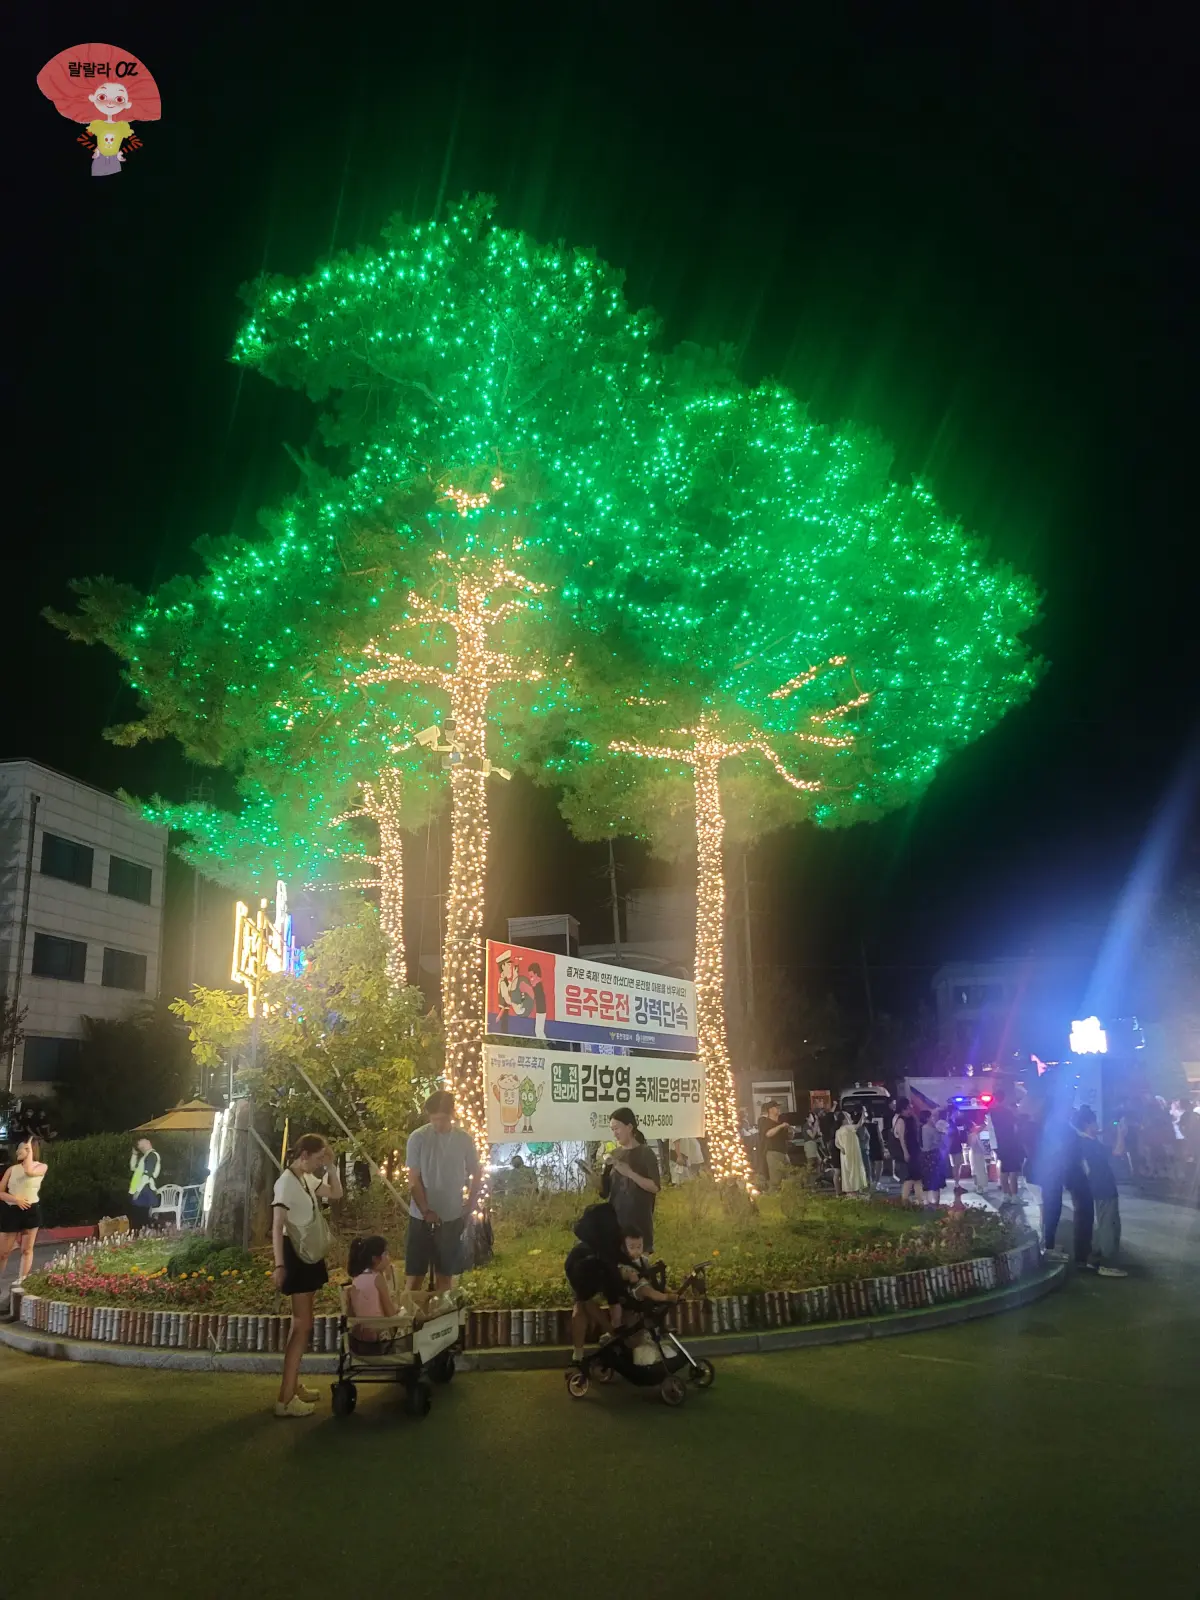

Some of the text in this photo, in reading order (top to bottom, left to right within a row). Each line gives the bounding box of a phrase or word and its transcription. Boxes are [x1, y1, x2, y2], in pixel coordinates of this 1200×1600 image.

[567, 966, 584, 979] 즐거운
[586, 970, 599, 982] 축제!
[565, 984, 688, 1030] 음주운전 강력단속
[517, 1055, 545, 1070] 맥주축제
[553, 1083, 577, 1100] 관리자
[581, 1064, 700, 1103] 김호영 축제운영부장
[636, 1114, 673, 1126] 3-439-5800
